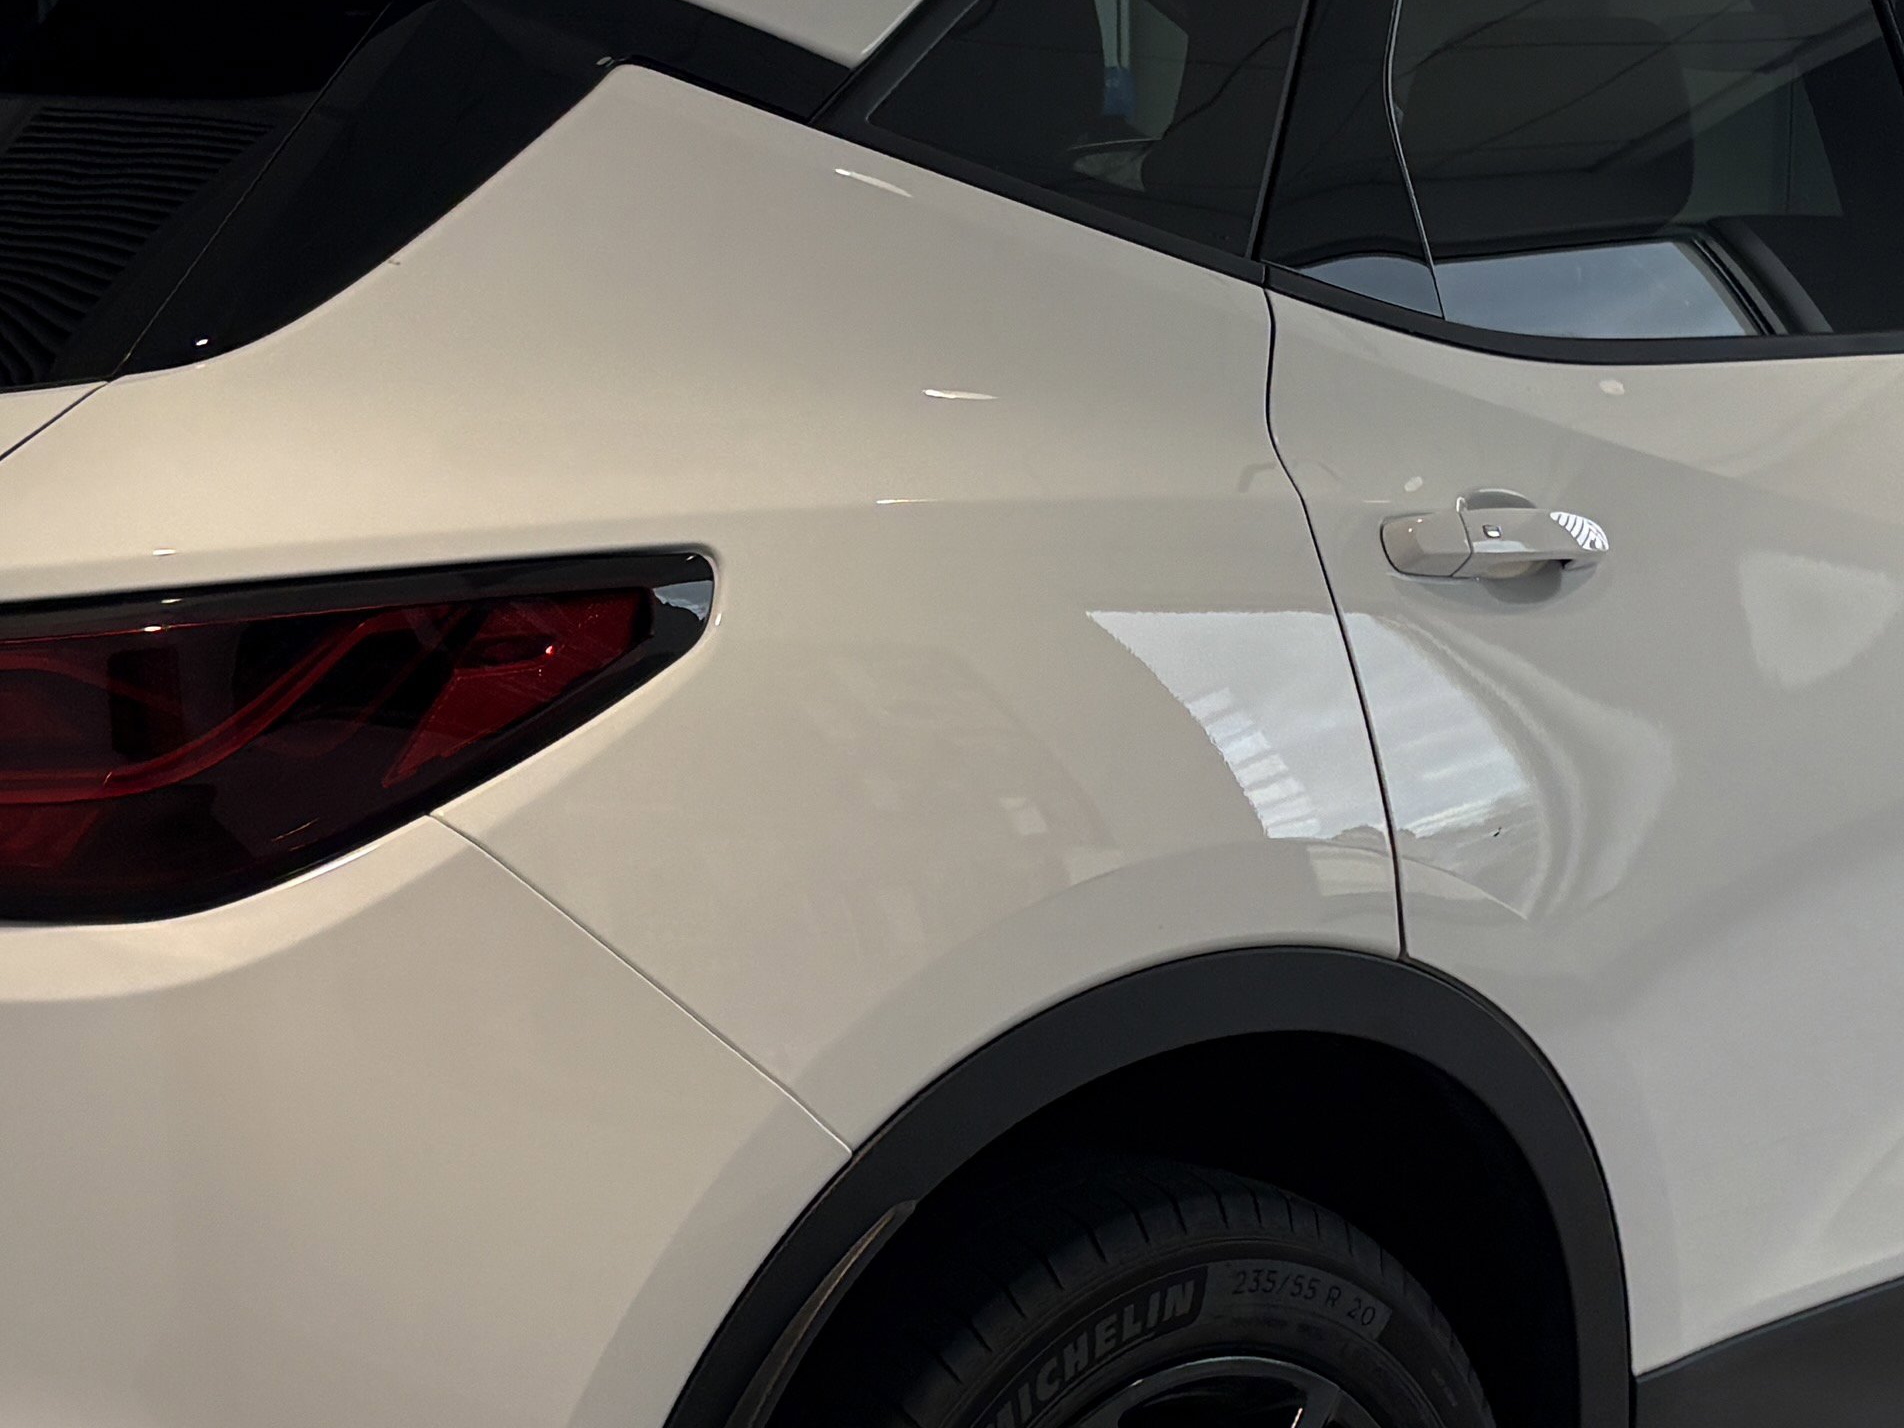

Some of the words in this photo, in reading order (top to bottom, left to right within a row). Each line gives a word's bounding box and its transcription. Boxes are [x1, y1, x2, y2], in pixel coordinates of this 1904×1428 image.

[1231, 1269, 1321, 1300] 235/55
[1325, 1285, 1342, 1309] R
[1347, 1296, 1377, 1326] 20
